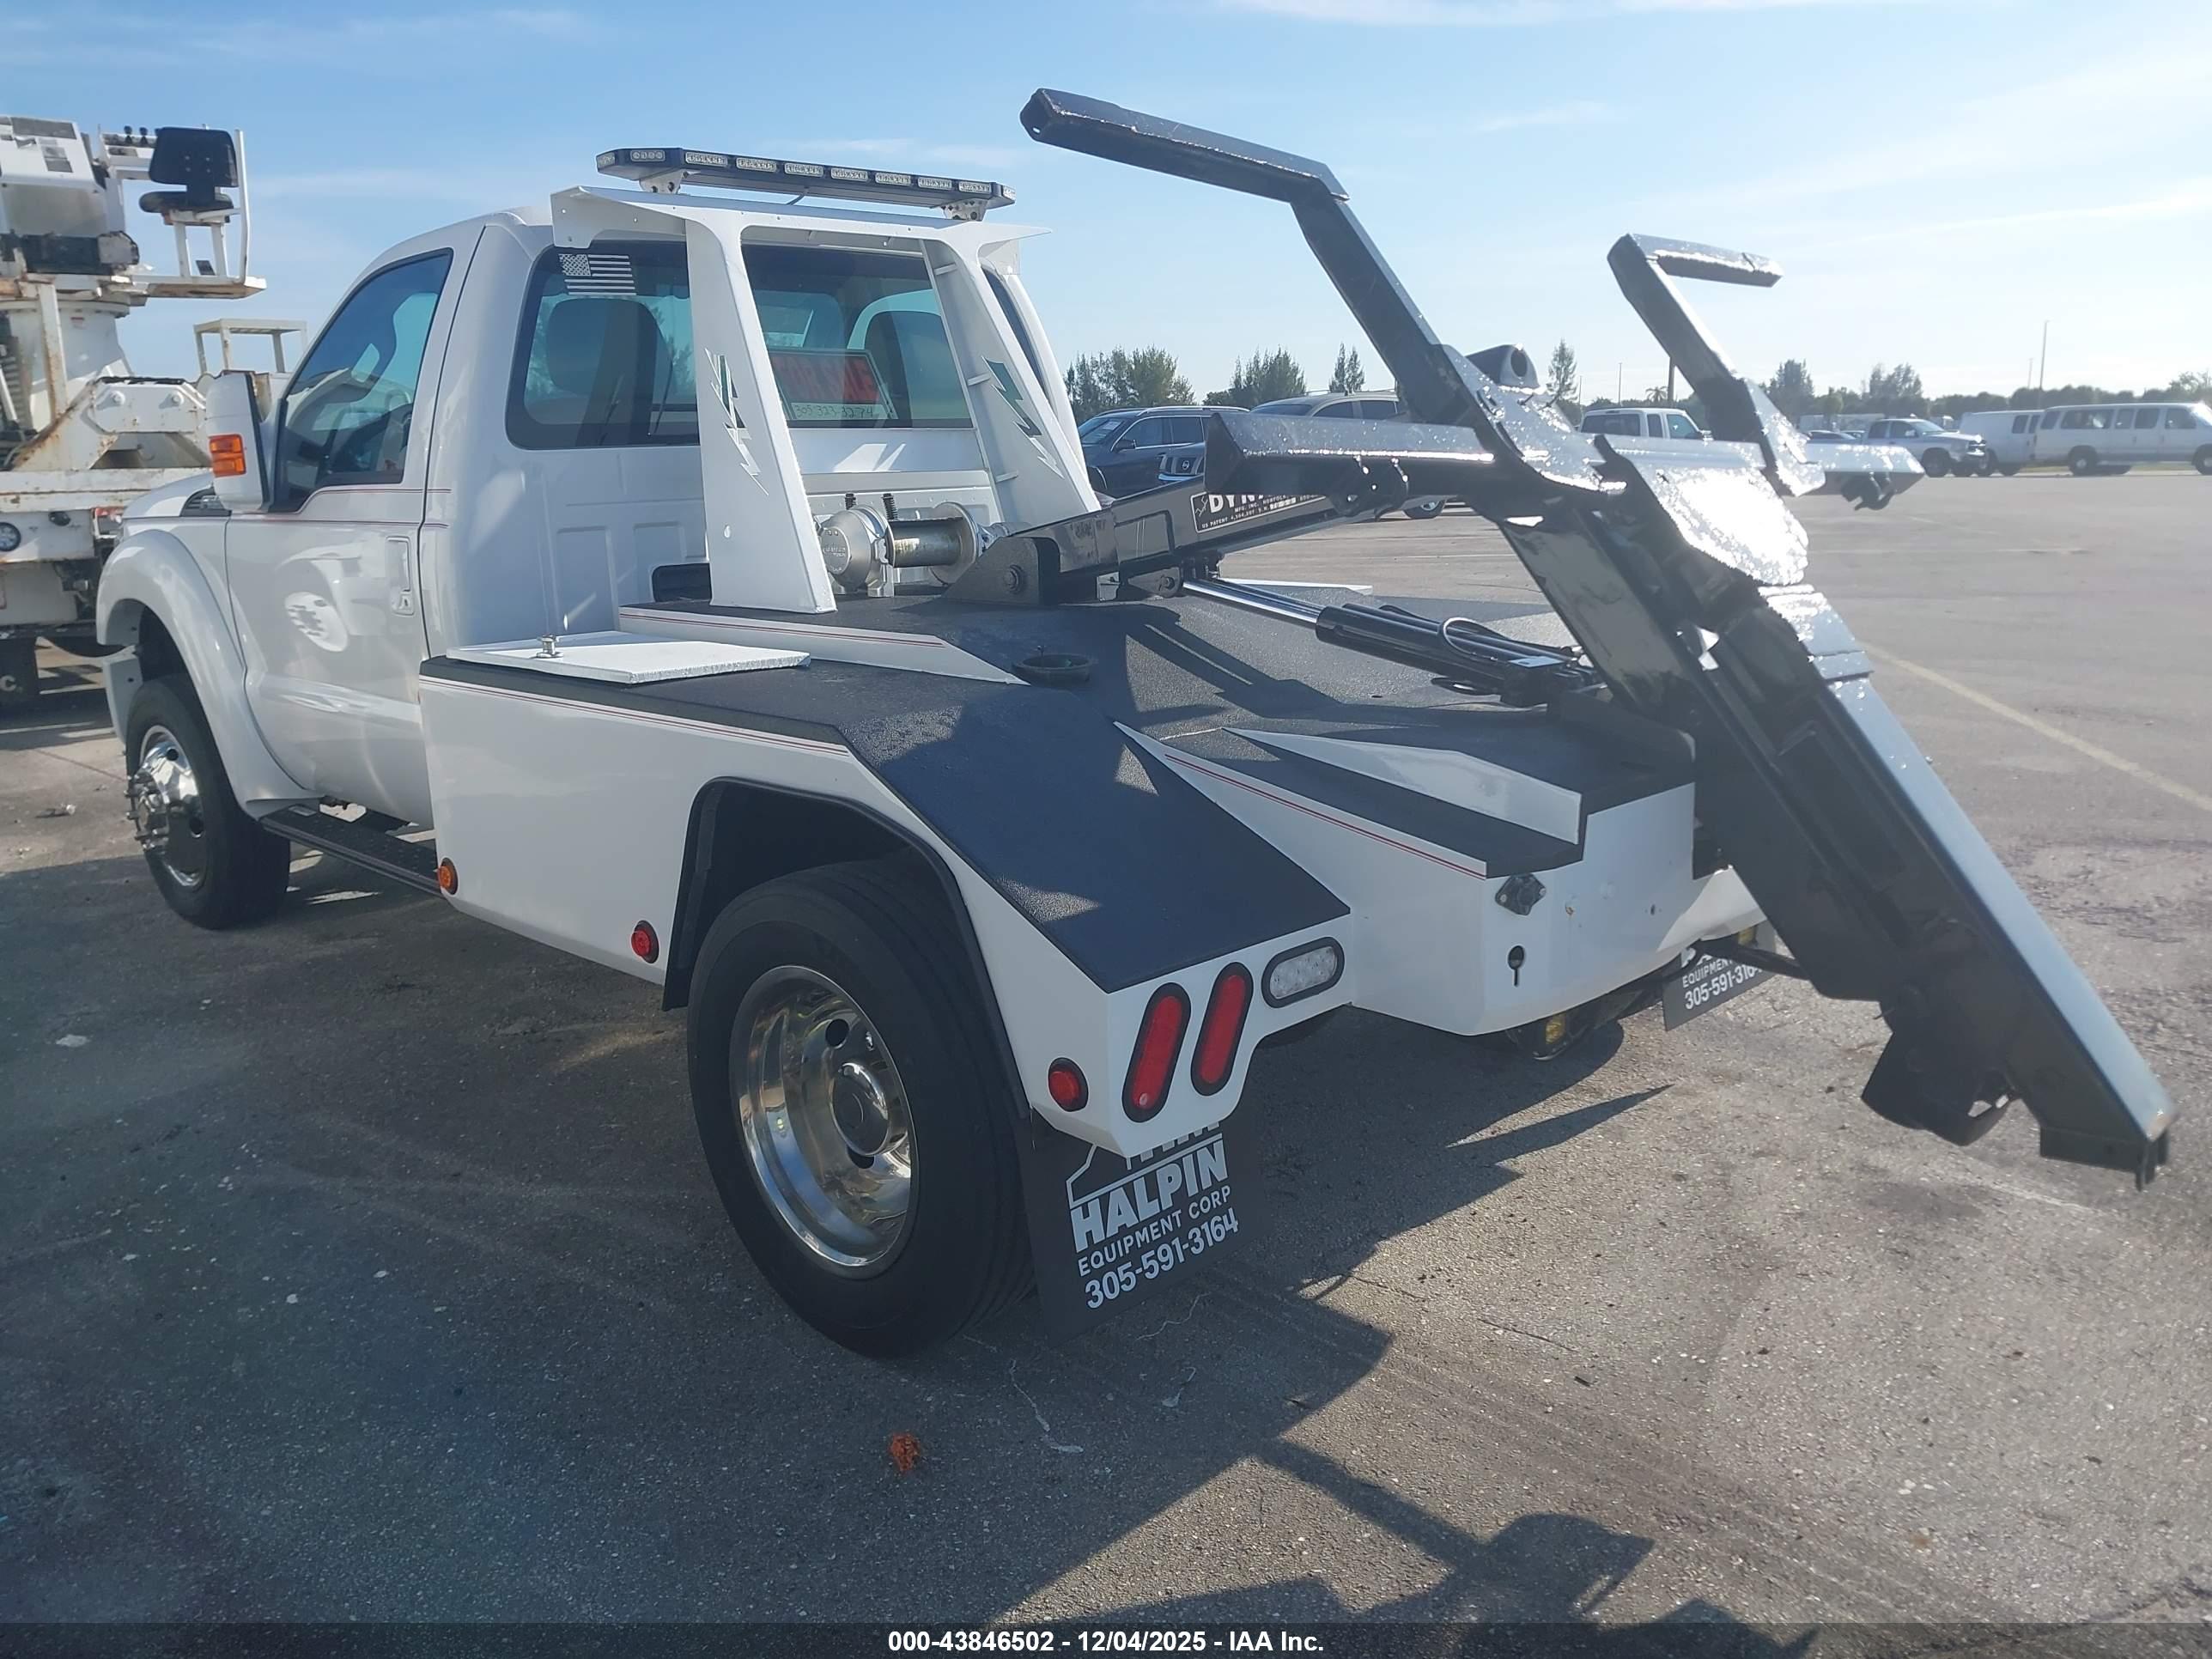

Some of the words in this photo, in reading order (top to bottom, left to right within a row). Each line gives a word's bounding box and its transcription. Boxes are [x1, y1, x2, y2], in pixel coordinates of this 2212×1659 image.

[1210, 516, 1228, 526] PATENT
[1070, 1139, 1229, 1254] HALPIN
[1078, 1209, 1182, 1277] EQUIPMENT
[1188, 1185, 1231, 1219] CORP
[1085, 1207, 1239, 1309] 305-591-3164
